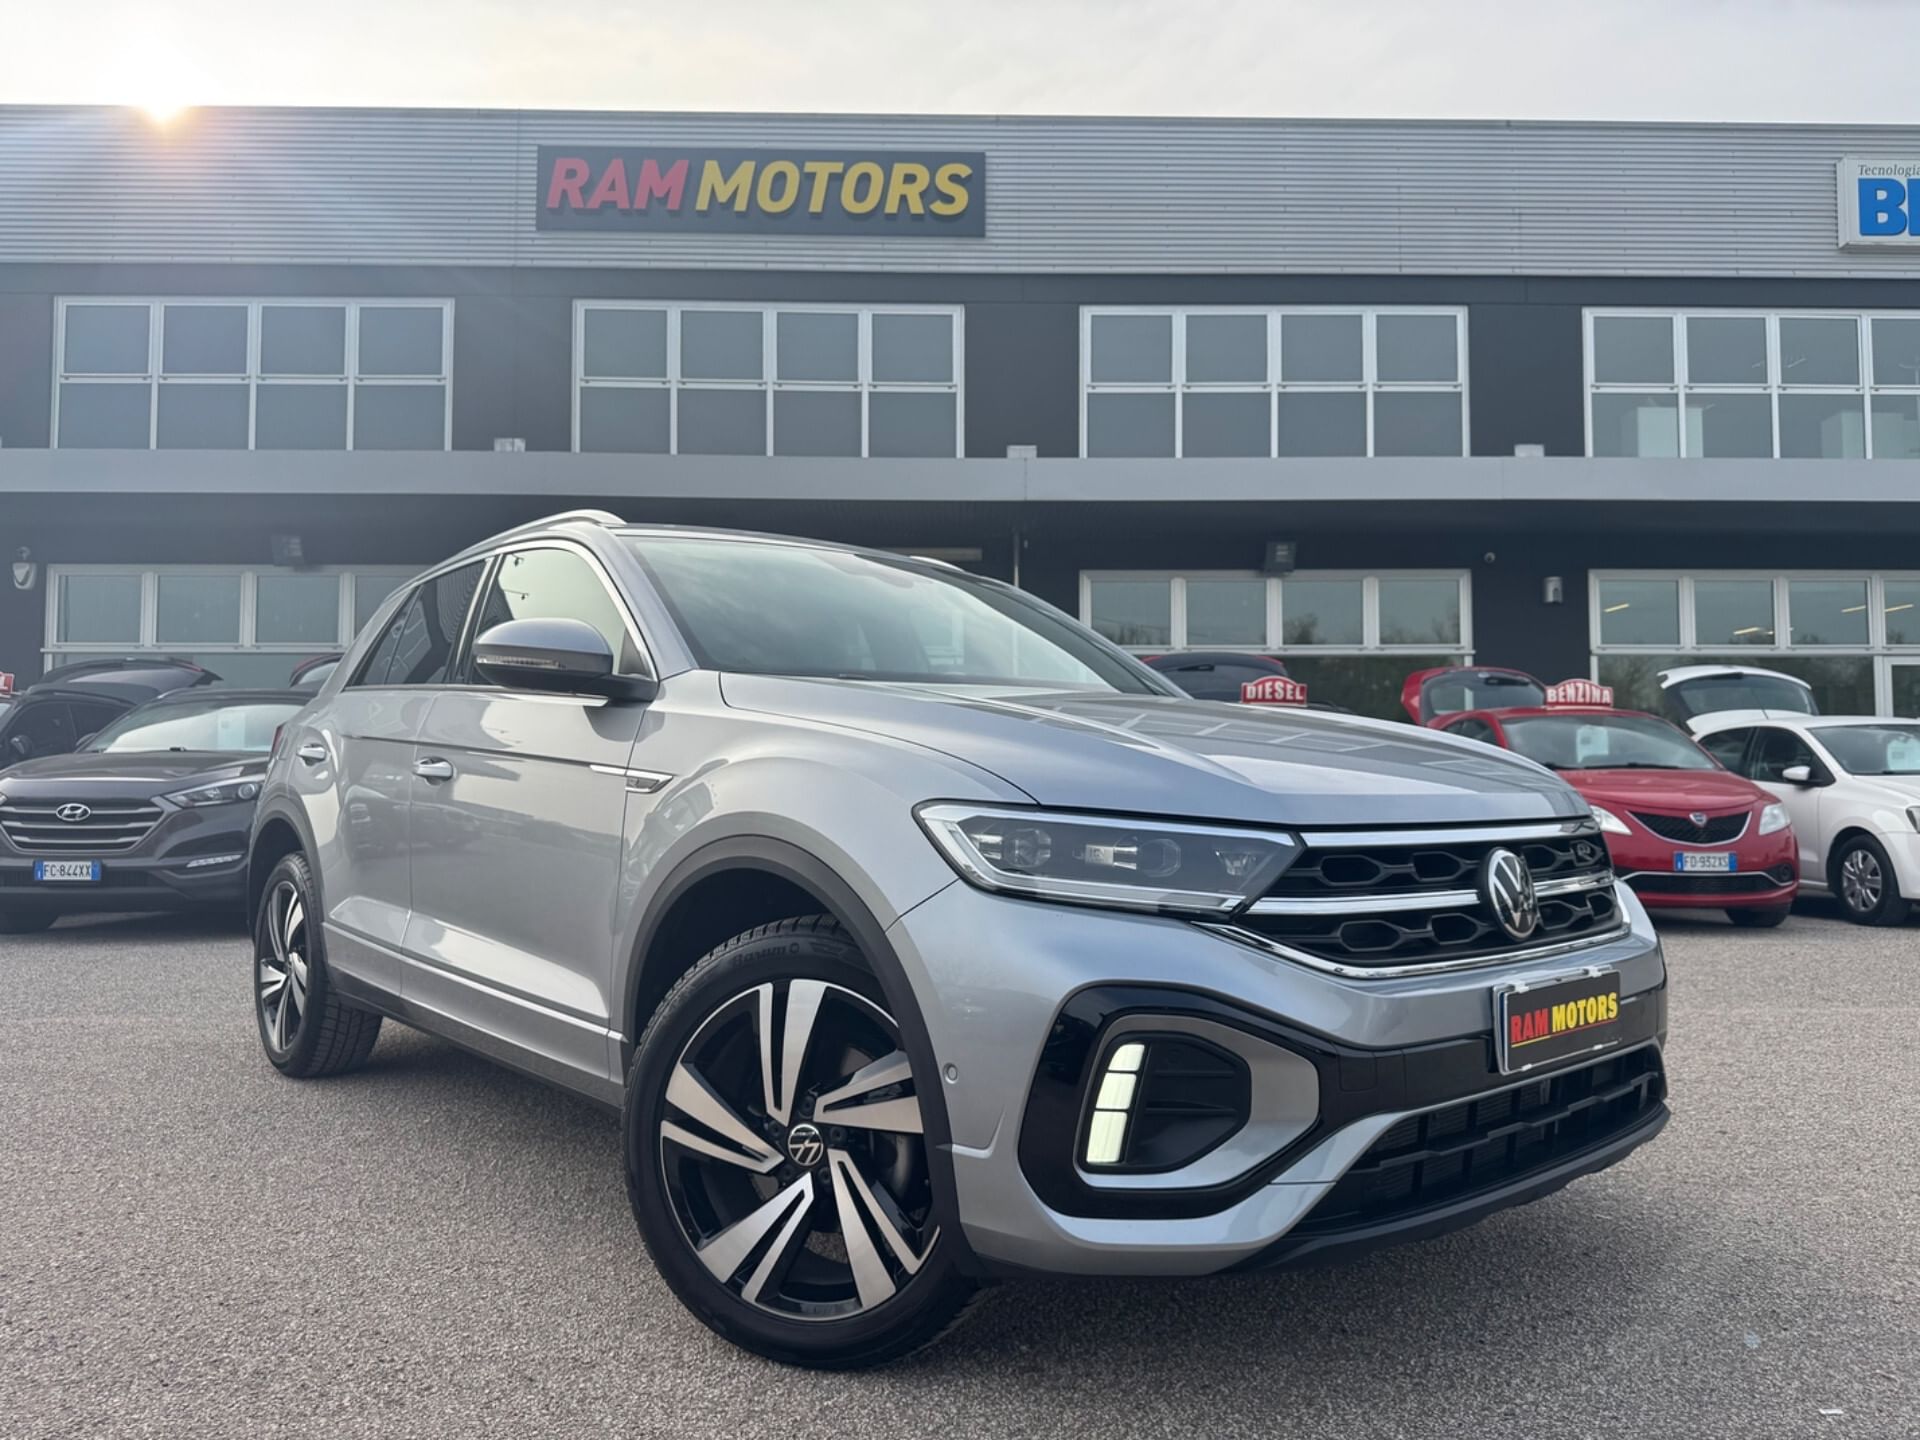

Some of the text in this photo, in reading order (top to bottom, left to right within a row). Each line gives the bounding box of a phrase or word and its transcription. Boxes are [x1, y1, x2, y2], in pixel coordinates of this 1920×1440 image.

[546, 157, 973, 216] RAM MOTORS
[1246, 681, 1304, 700] DIESEL
[1546, 682, 1611, 704] BENZINA
[1510, 991, 1618, 1045] RAM MOTORS
